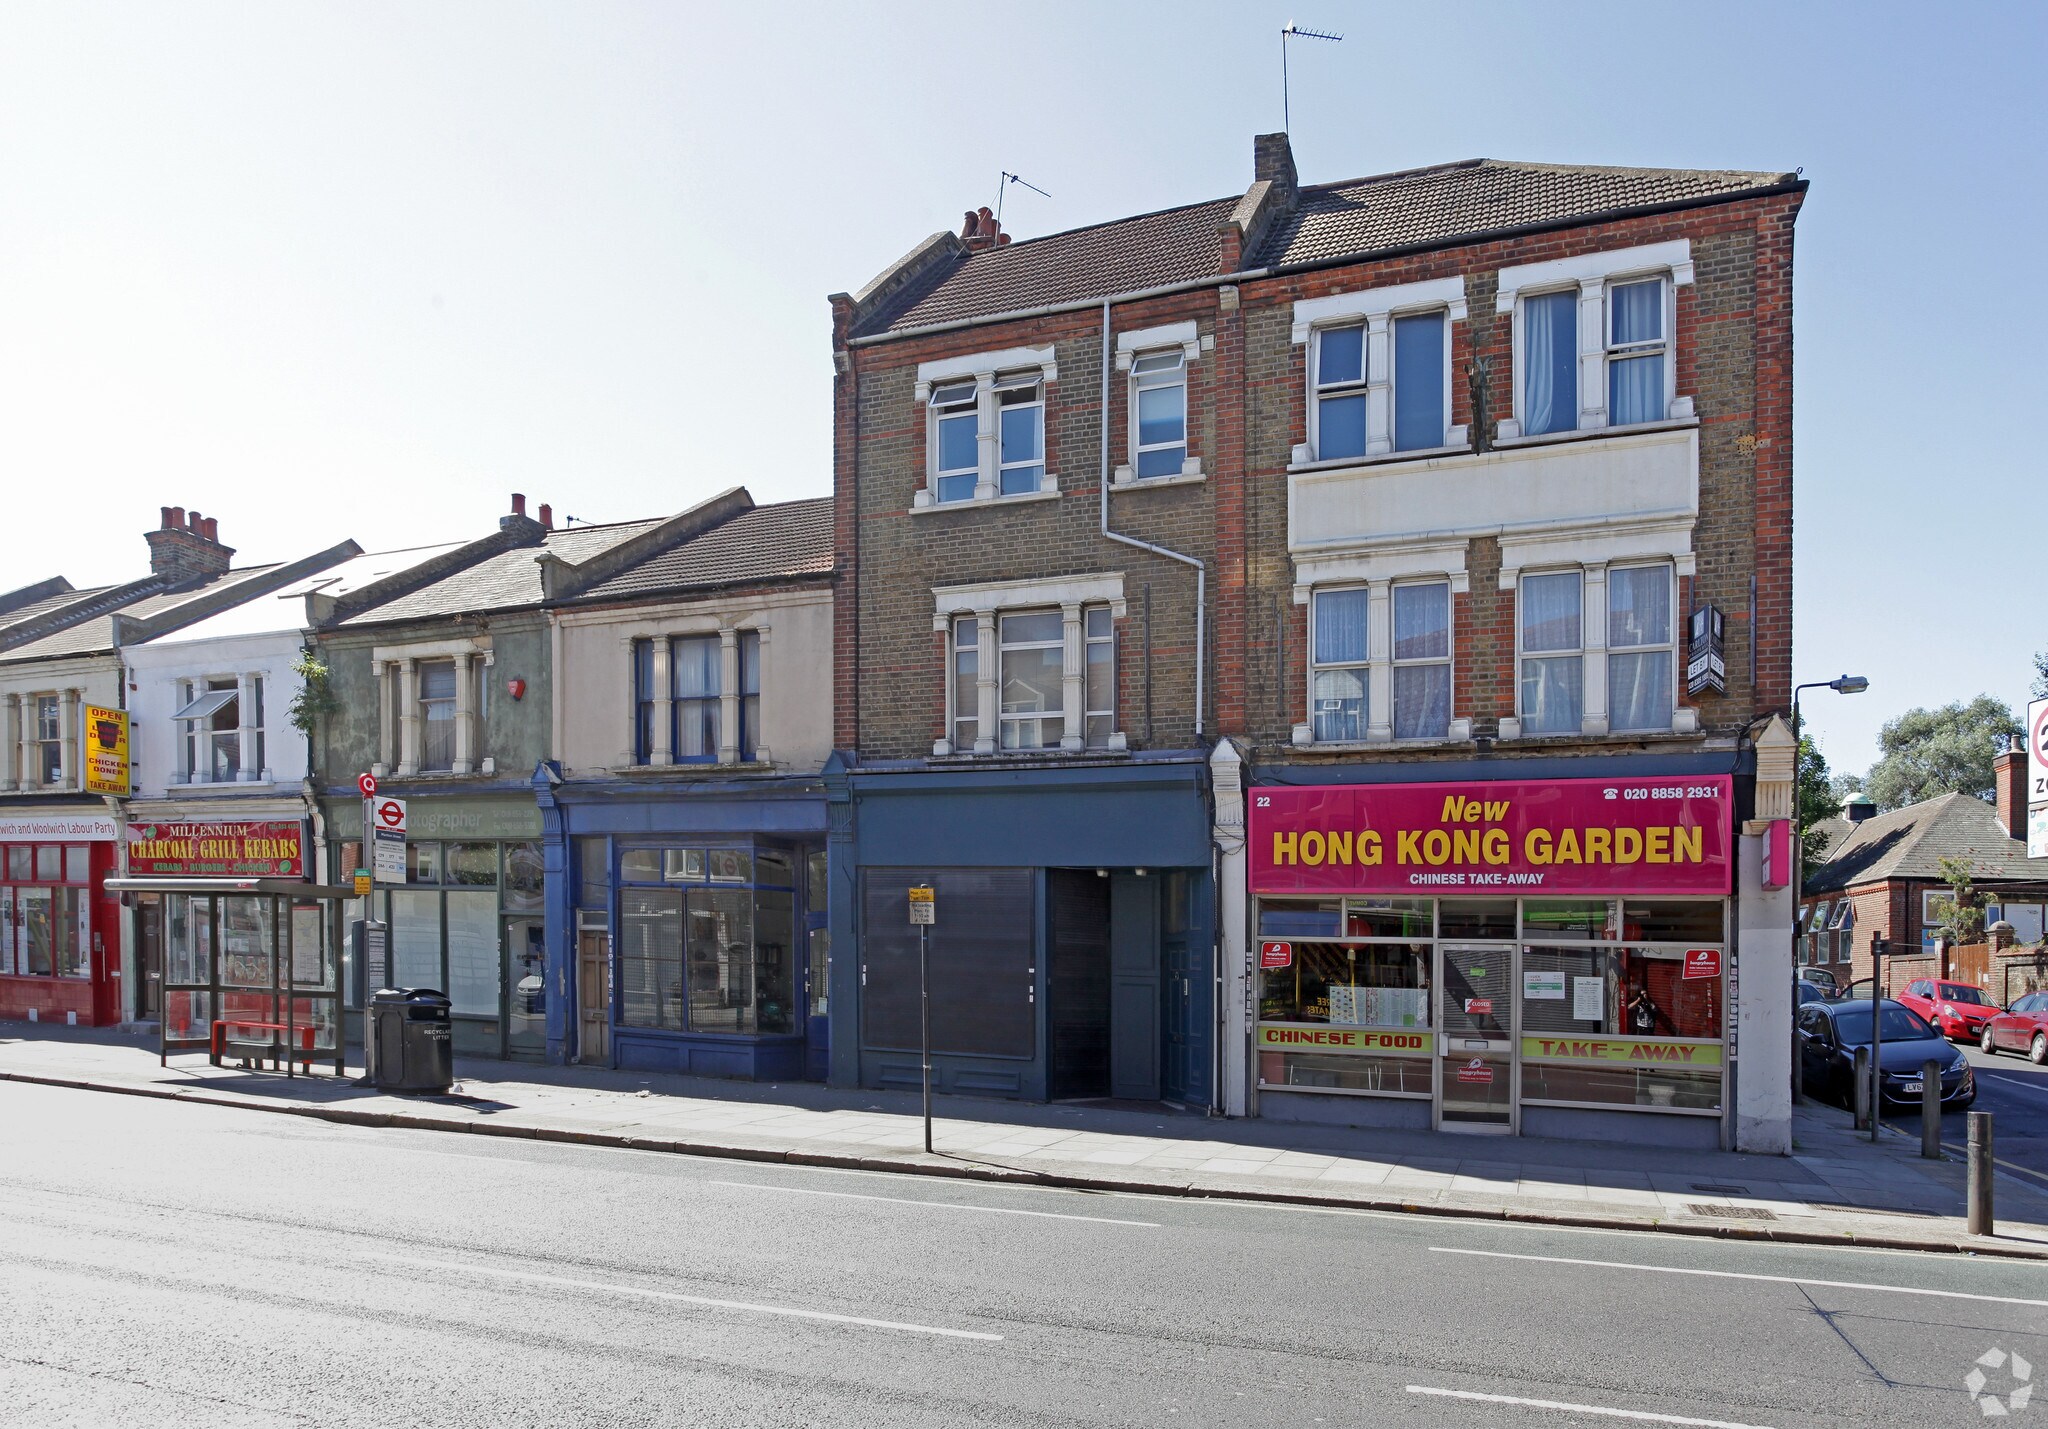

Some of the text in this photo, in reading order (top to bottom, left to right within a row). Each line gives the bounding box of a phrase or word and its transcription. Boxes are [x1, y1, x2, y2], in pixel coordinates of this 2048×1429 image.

[91, 708, 122, 721] OPEN
[90, 732, 126, 744] DONER
[89, 757, 128, 769] CHICKEN
[93, 766, 124, 776] DONER
[90, 780, 127, 793] TAKE AWAY
[363, 777, 375, 792] Q
[1624, 786, 1719, 800] 020 8858 2931
[1256, 797, 1271, 807] 22
[1440, 795, 1511, 823] New
[408, 809, 483, 833] otographer
[18, 823, 31, 834] and
[32, 822, 67, 834] Woolwich
[68, 822, 93, 834] Labour
[95, 821, 115, 836] Party
[169, 825, 248, 837] MILLENNIUM
[131, 838, 298, 859] CHARCOAL GRILL KEBABS
[1273, 826, 1703, 866] HONG KONG GARDEN
[153, 862, 183, 872] KEBABS
[189, 862, 226, 872] BURGERS
[1409, 873, 1545, 885] CHINESE TAKE-AWAY
[1266, 1029, 1423, 1049] CHINESE FOOD
